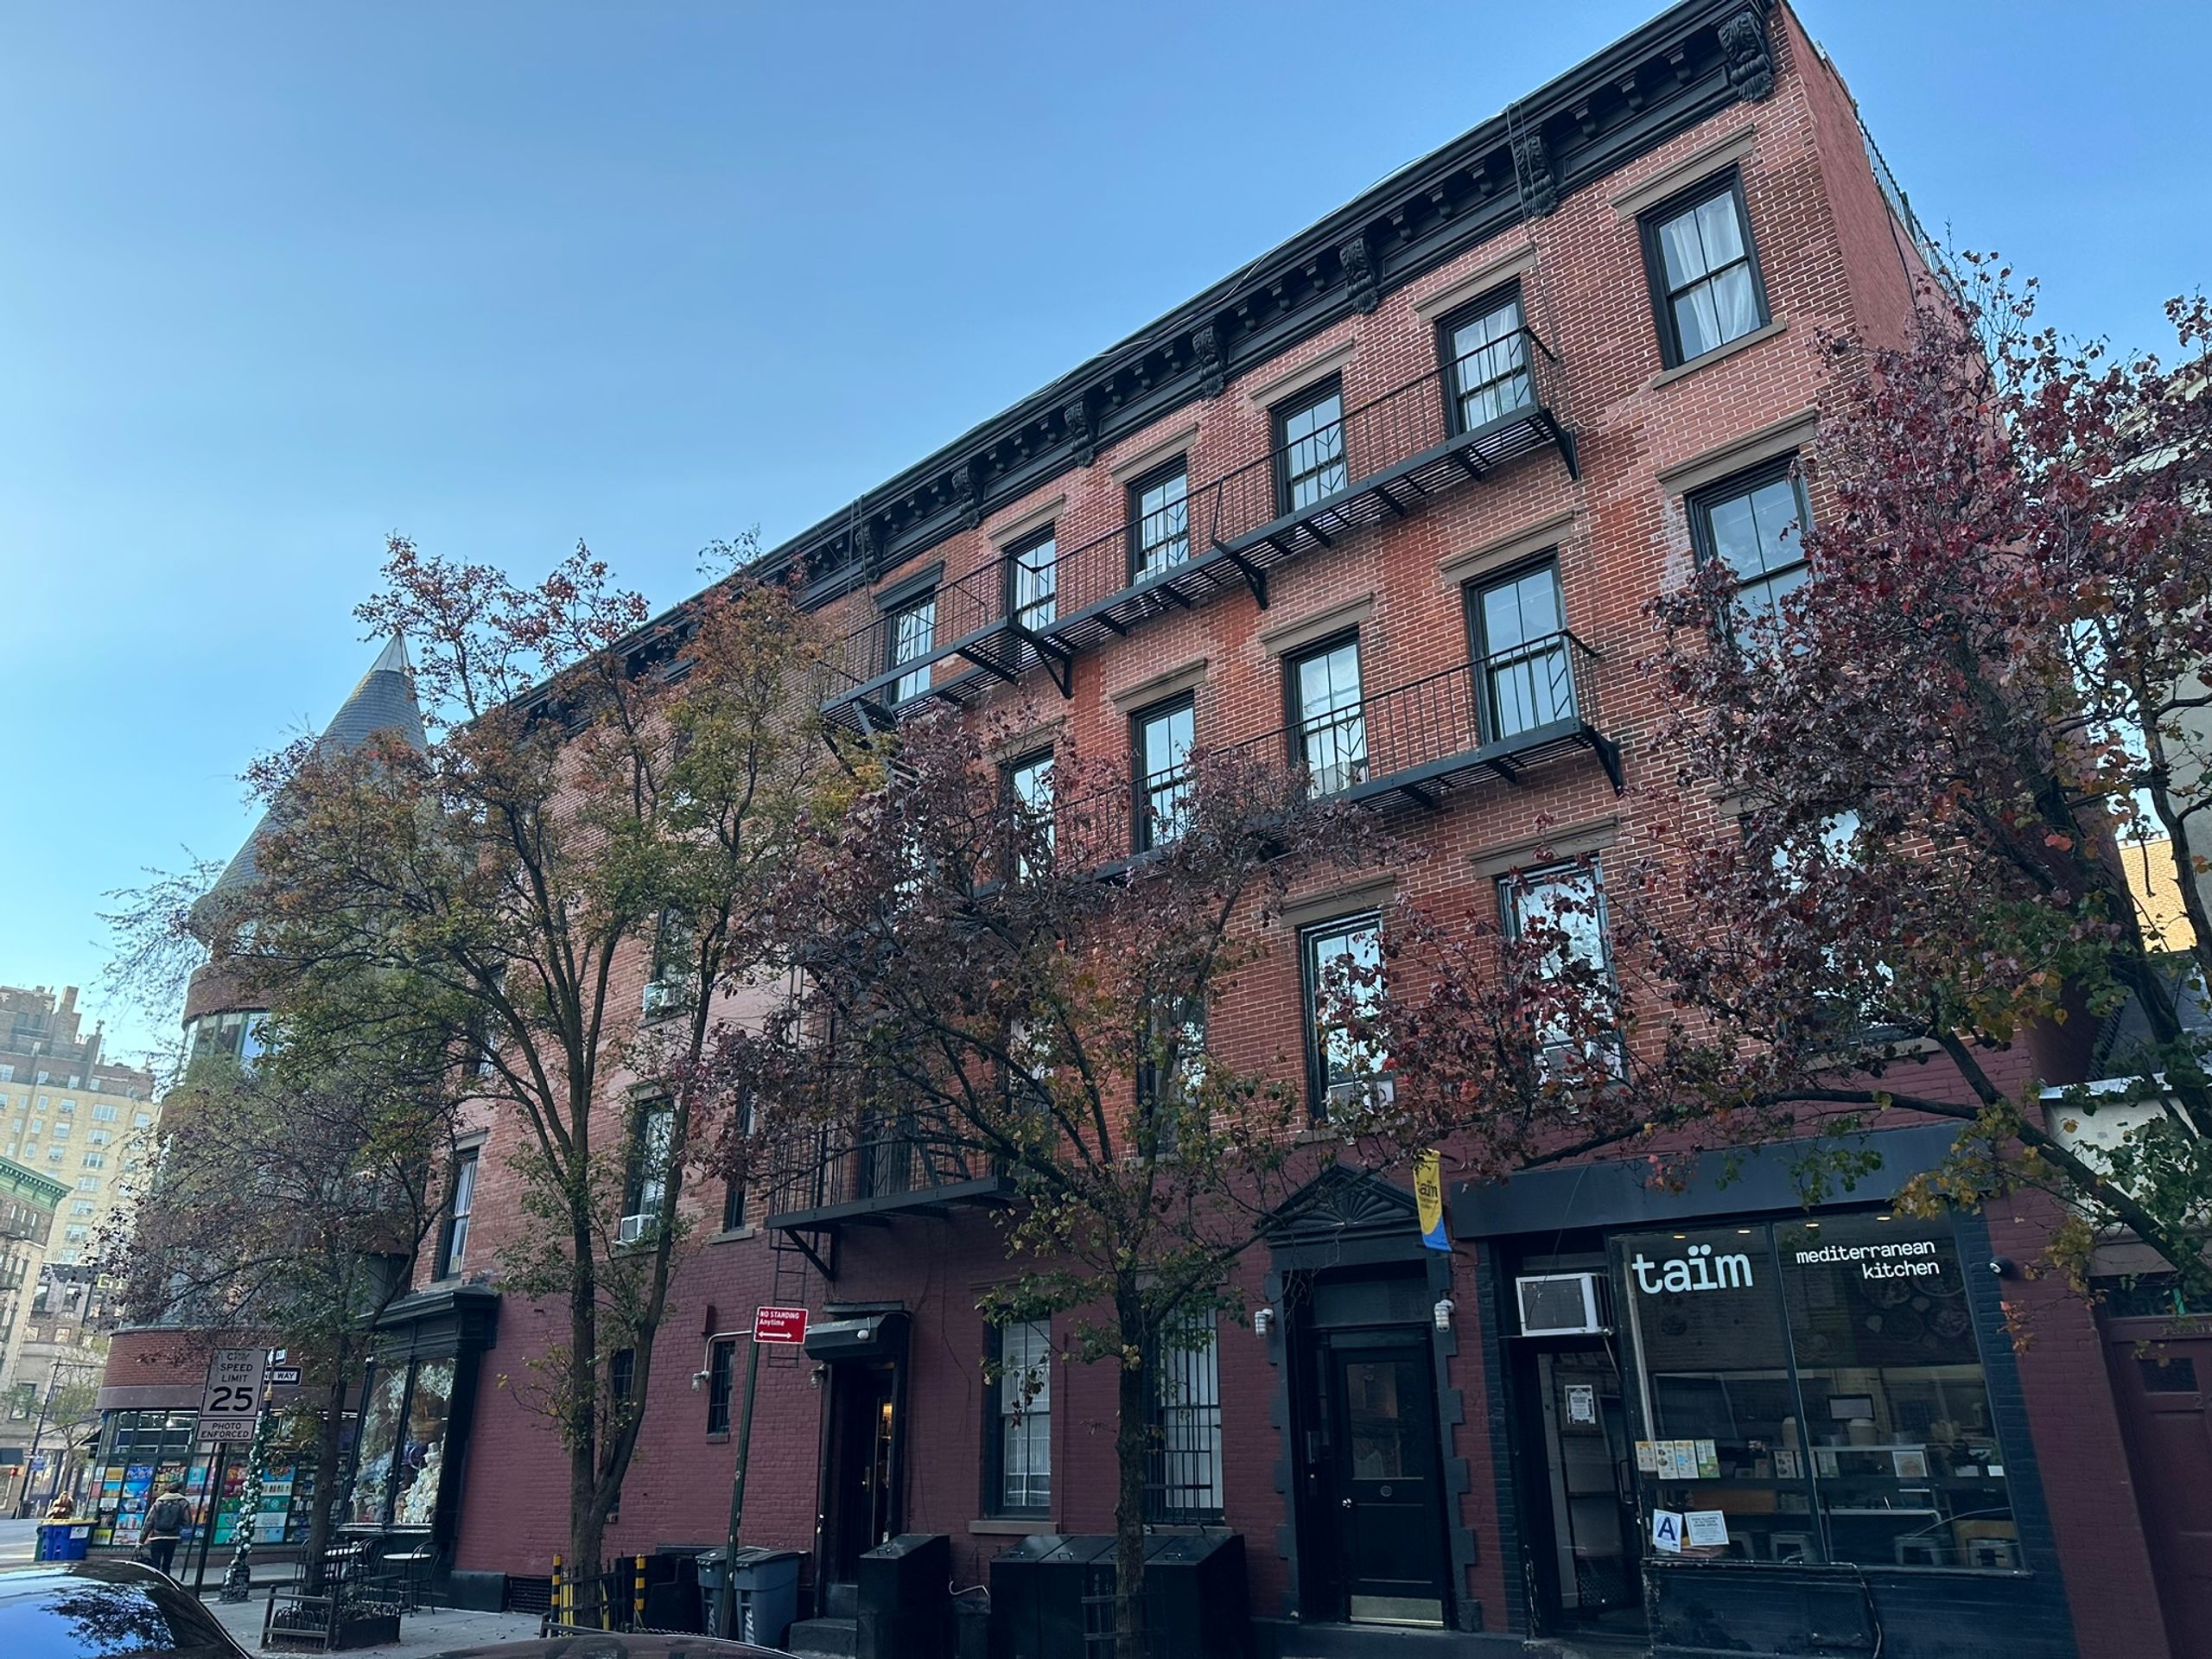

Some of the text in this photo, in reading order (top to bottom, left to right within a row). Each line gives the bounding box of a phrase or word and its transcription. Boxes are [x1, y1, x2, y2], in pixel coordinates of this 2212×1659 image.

[1418, 1179, 1438, 1198] aïm
[1796, 1241, 1936, 1264] mediterranean
[1631, 1243, 1753, 1294] taïm
[1861, 1260, 1940, 1280] kitchen
[770, 1311, 799, 1319] STANDING
[220, 1363, 253, 1372] SPEED
[277, 1371, 295, 1380] WAY
[221, 1374, 249, 1382] LIMIT
[208, 1386, 253, 1412] 25
[200, 1430, 250, 1439] ENFORCED
[1656, 1516, 1676, 1541] A
